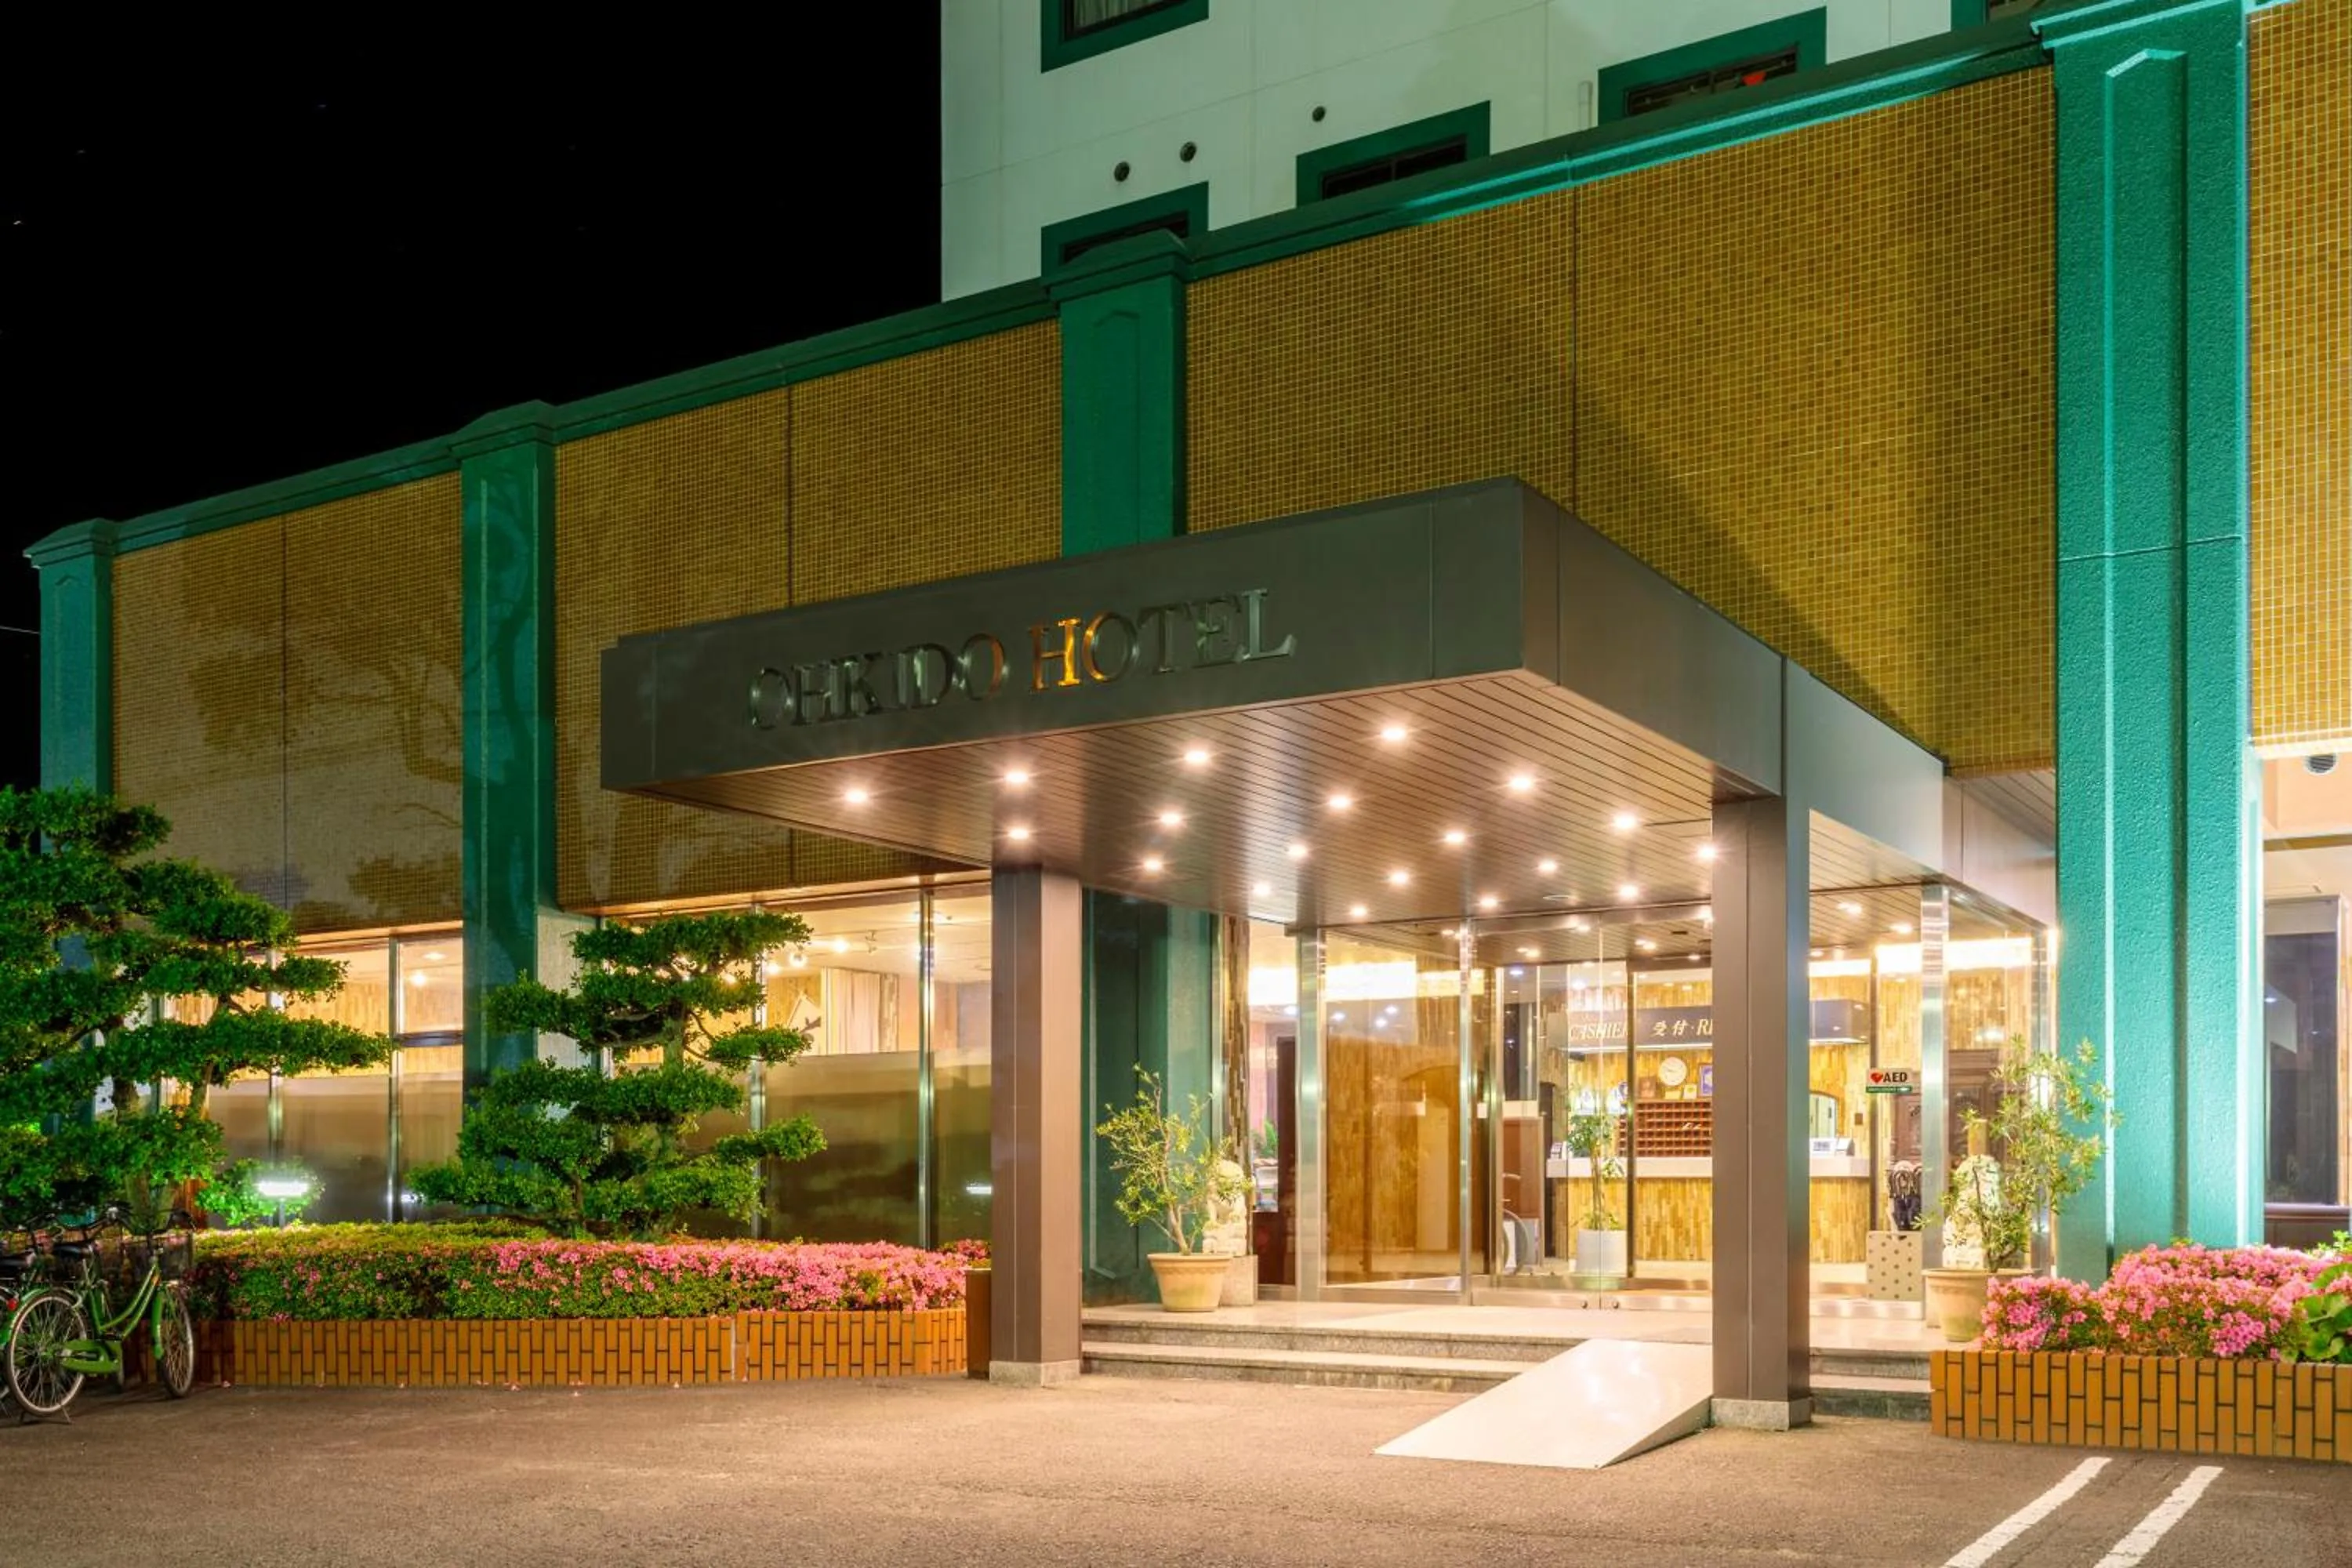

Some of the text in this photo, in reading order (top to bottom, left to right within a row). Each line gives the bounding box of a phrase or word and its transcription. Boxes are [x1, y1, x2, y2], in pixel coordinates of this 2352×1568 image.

[748, 588, 1297, 731] OHKIDO HOTEL
[1882, 1072, 1907, 1083] AED
